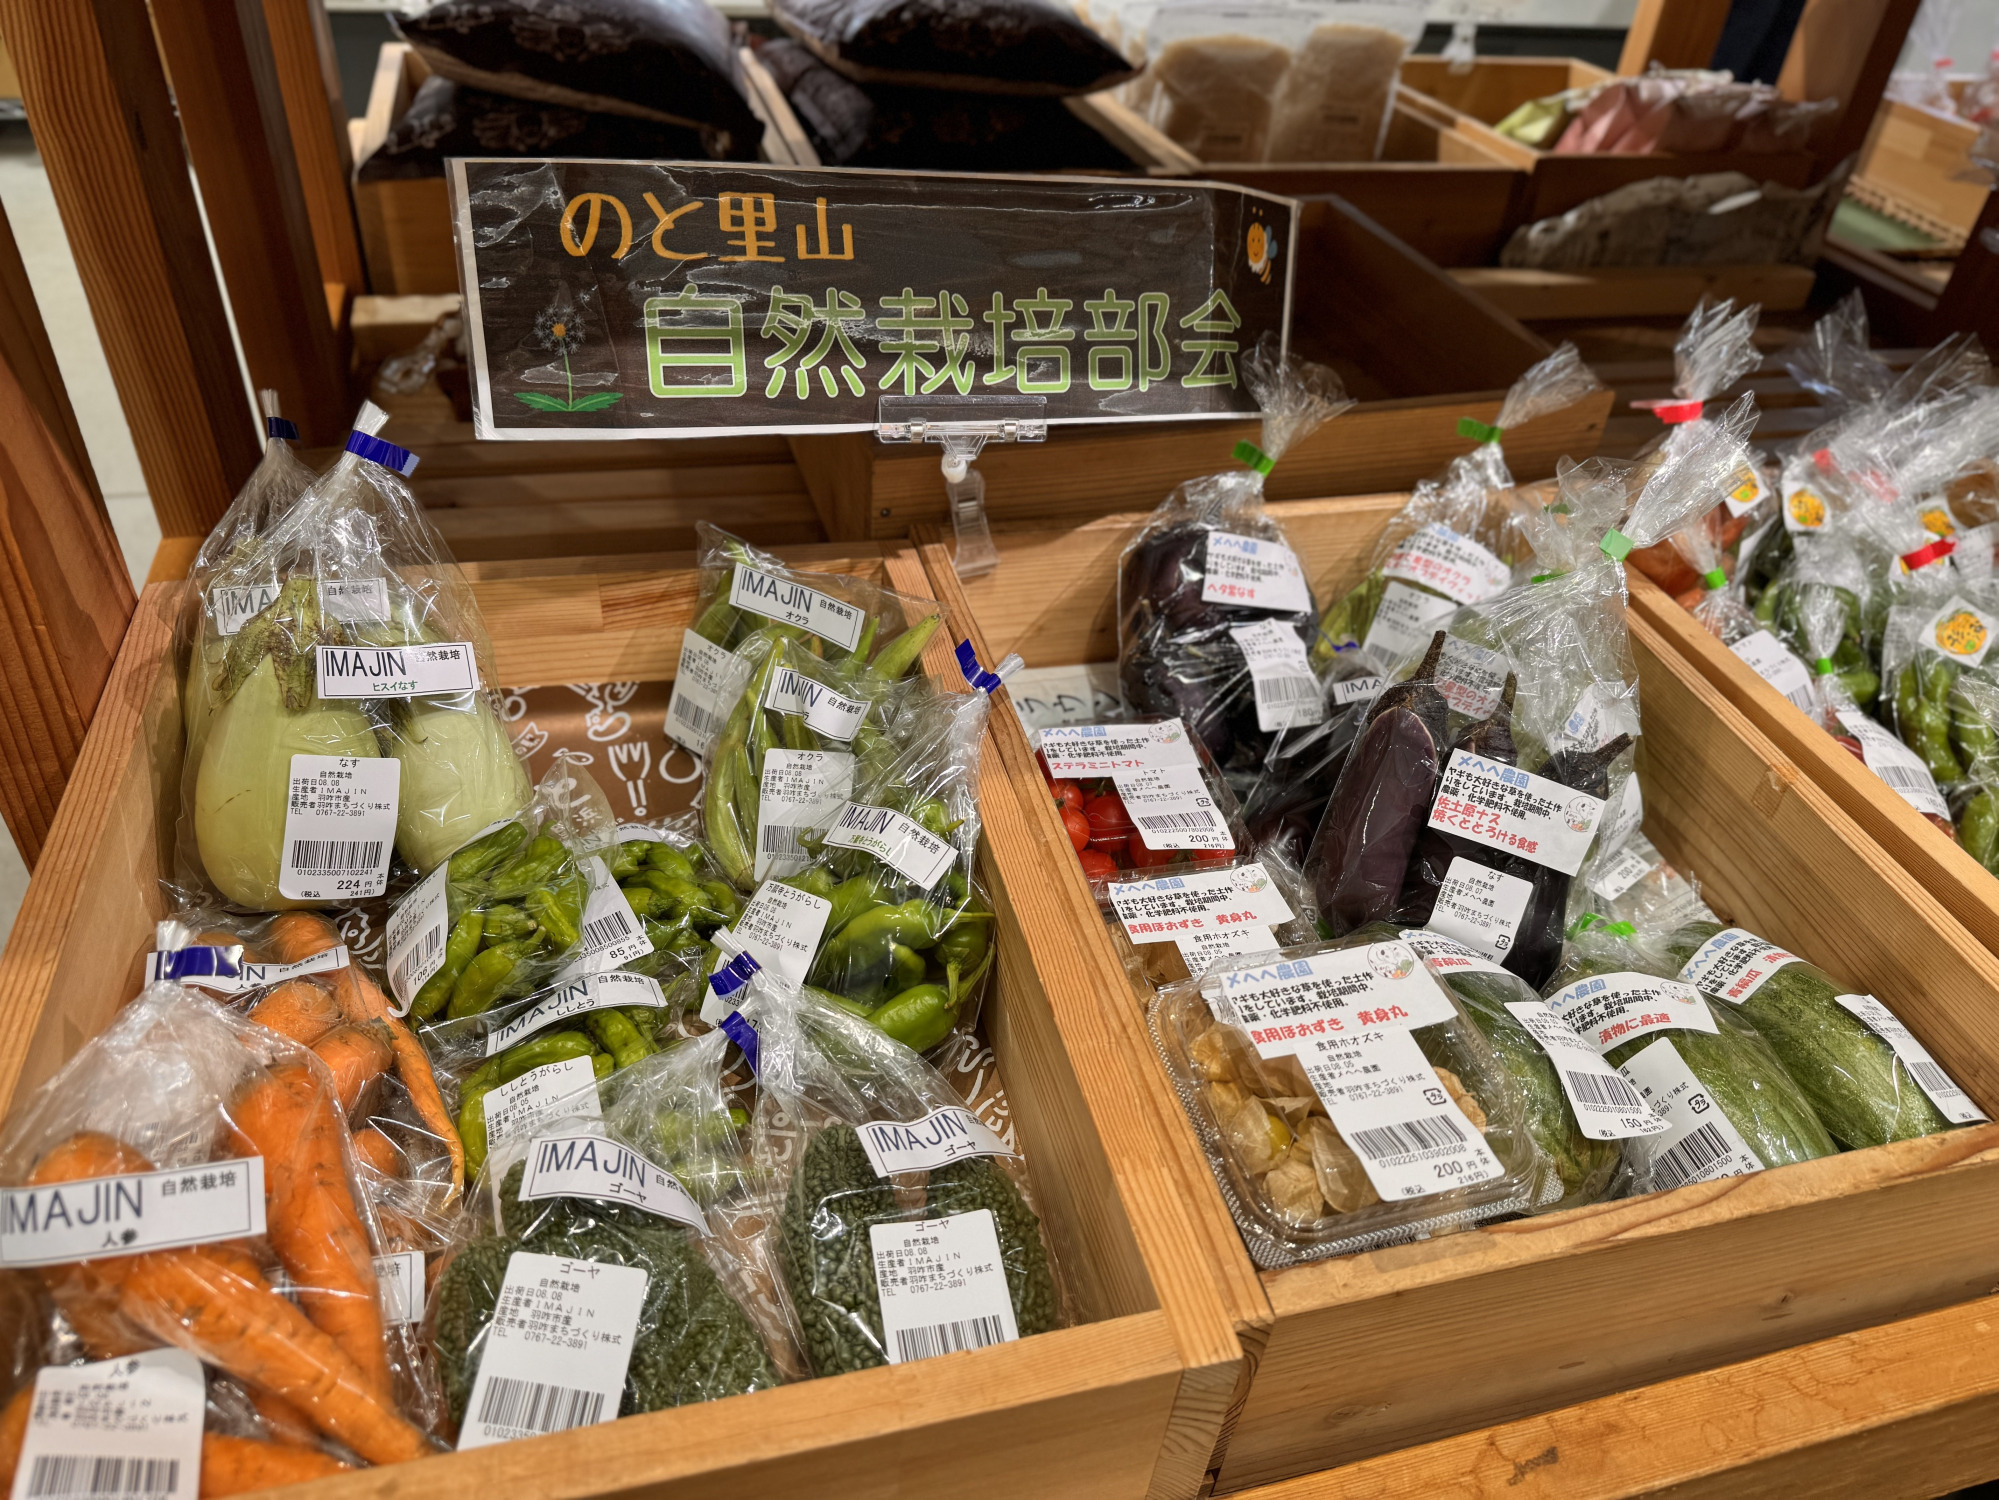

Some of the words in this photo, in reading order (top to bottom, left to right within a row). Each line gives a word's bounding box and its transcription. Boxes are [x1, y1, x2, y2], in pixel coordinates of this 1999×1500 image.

[560, 192, 855, 262] のと里山
[643, 283, 1242, 400] 自然栽培部会
[742, 570, 812, 612] IMAJIN
[820, 599, 852, 619] 自然栽培
[786, 611, 808, 625] オクラ
[325, 651, 407, 677] IMAJIN
[373, 680, 418, 691] ヒスイなす
[828, 697, 861, 714] 自然栽培
[339, 758, 360, 767] なす
[797, 752, 823, 761] オクラ
[1052, 760, 1144, 770] ステラミニトマト
[320, 771, 352, 779] 自然栽培
[1458, 756, 1529, 789] メヘヘ農園
[1449, 767, 1562, 812] ヤギも大好きな草を使った土作
[1437, 796, 1501, 825] 佐土原ナス
[840, 806, 896, 835] IMAJIN
[898, 823, 941, 855] 自然栽培
[1432, 809, 1539, 854] 焼くととろける食感
[337, 880, 360, 890] 224
[1488, 871, 1504, 882] なす
[766, 883, 821, 910] 万願寺とうがらし
[1114, 878, 1185, 896] メヘヘ農園
[1128, 918, 1205, 934] 食用ほおずき
[1215, 911, 1257, 925] 黄身丸
[1193, 930, 1250, 943] 食用ホオズキ
[610, 947, 625, 958] 85
[413, 966, 428, 986] 106
[1227, 960, 1314, 988] メヘヘ農園
[1551, 979, 1606, 1010] ヘヘ農園
[500, 980, 589, 1042] IMAJIN
[598, 975, 644, 985] 自然栽培
[556, 999, 595, 1016] ししとう
[1250, 1018, 1344, 1045] 食用ほおずき
[1357, 1005, 1408, 1026] 黄身丸
[1599, 1013, 1671, 1044] 漬物に最適
[1315, 1032, 1384, 1051] 食用ホオズキ
[500, 1063, 573, 1097] ししとうがらし
[872, 1111, 967, 1152] IMAJIN
[1620, 1118, 1642, 1129] 150
[945, 1141, 976, 1156] ゴーヤ
[539, 1140, 646, 1188] IMAJIN
[1434, 1160, 1463, 1178] 200
[1739, 1154, 1755, 1171] 本体
[162, 1171, 237, 1197] 自然栽培
[609, 1182, 647, 1203] ゴーヤ
[915, 1220, 949, 1231] ゴーヤ
[102, 1228, 138, 1248] 人参
[904, 1236, 939, 1248] 自然栽培
[560, 1262, 600, 1279] ゴーヤ
[880, 1269, 897, 1278] 産地
[540, 1278, 580, 1293] 自然栽培
[881, 1288, 896, 1297] TEL
[910, 1279, 966, 1293] 0767-22-3891
[492, 1327, 508, 1338] TEL
[525, 1331, 588, 1351] 0767-22-3891
